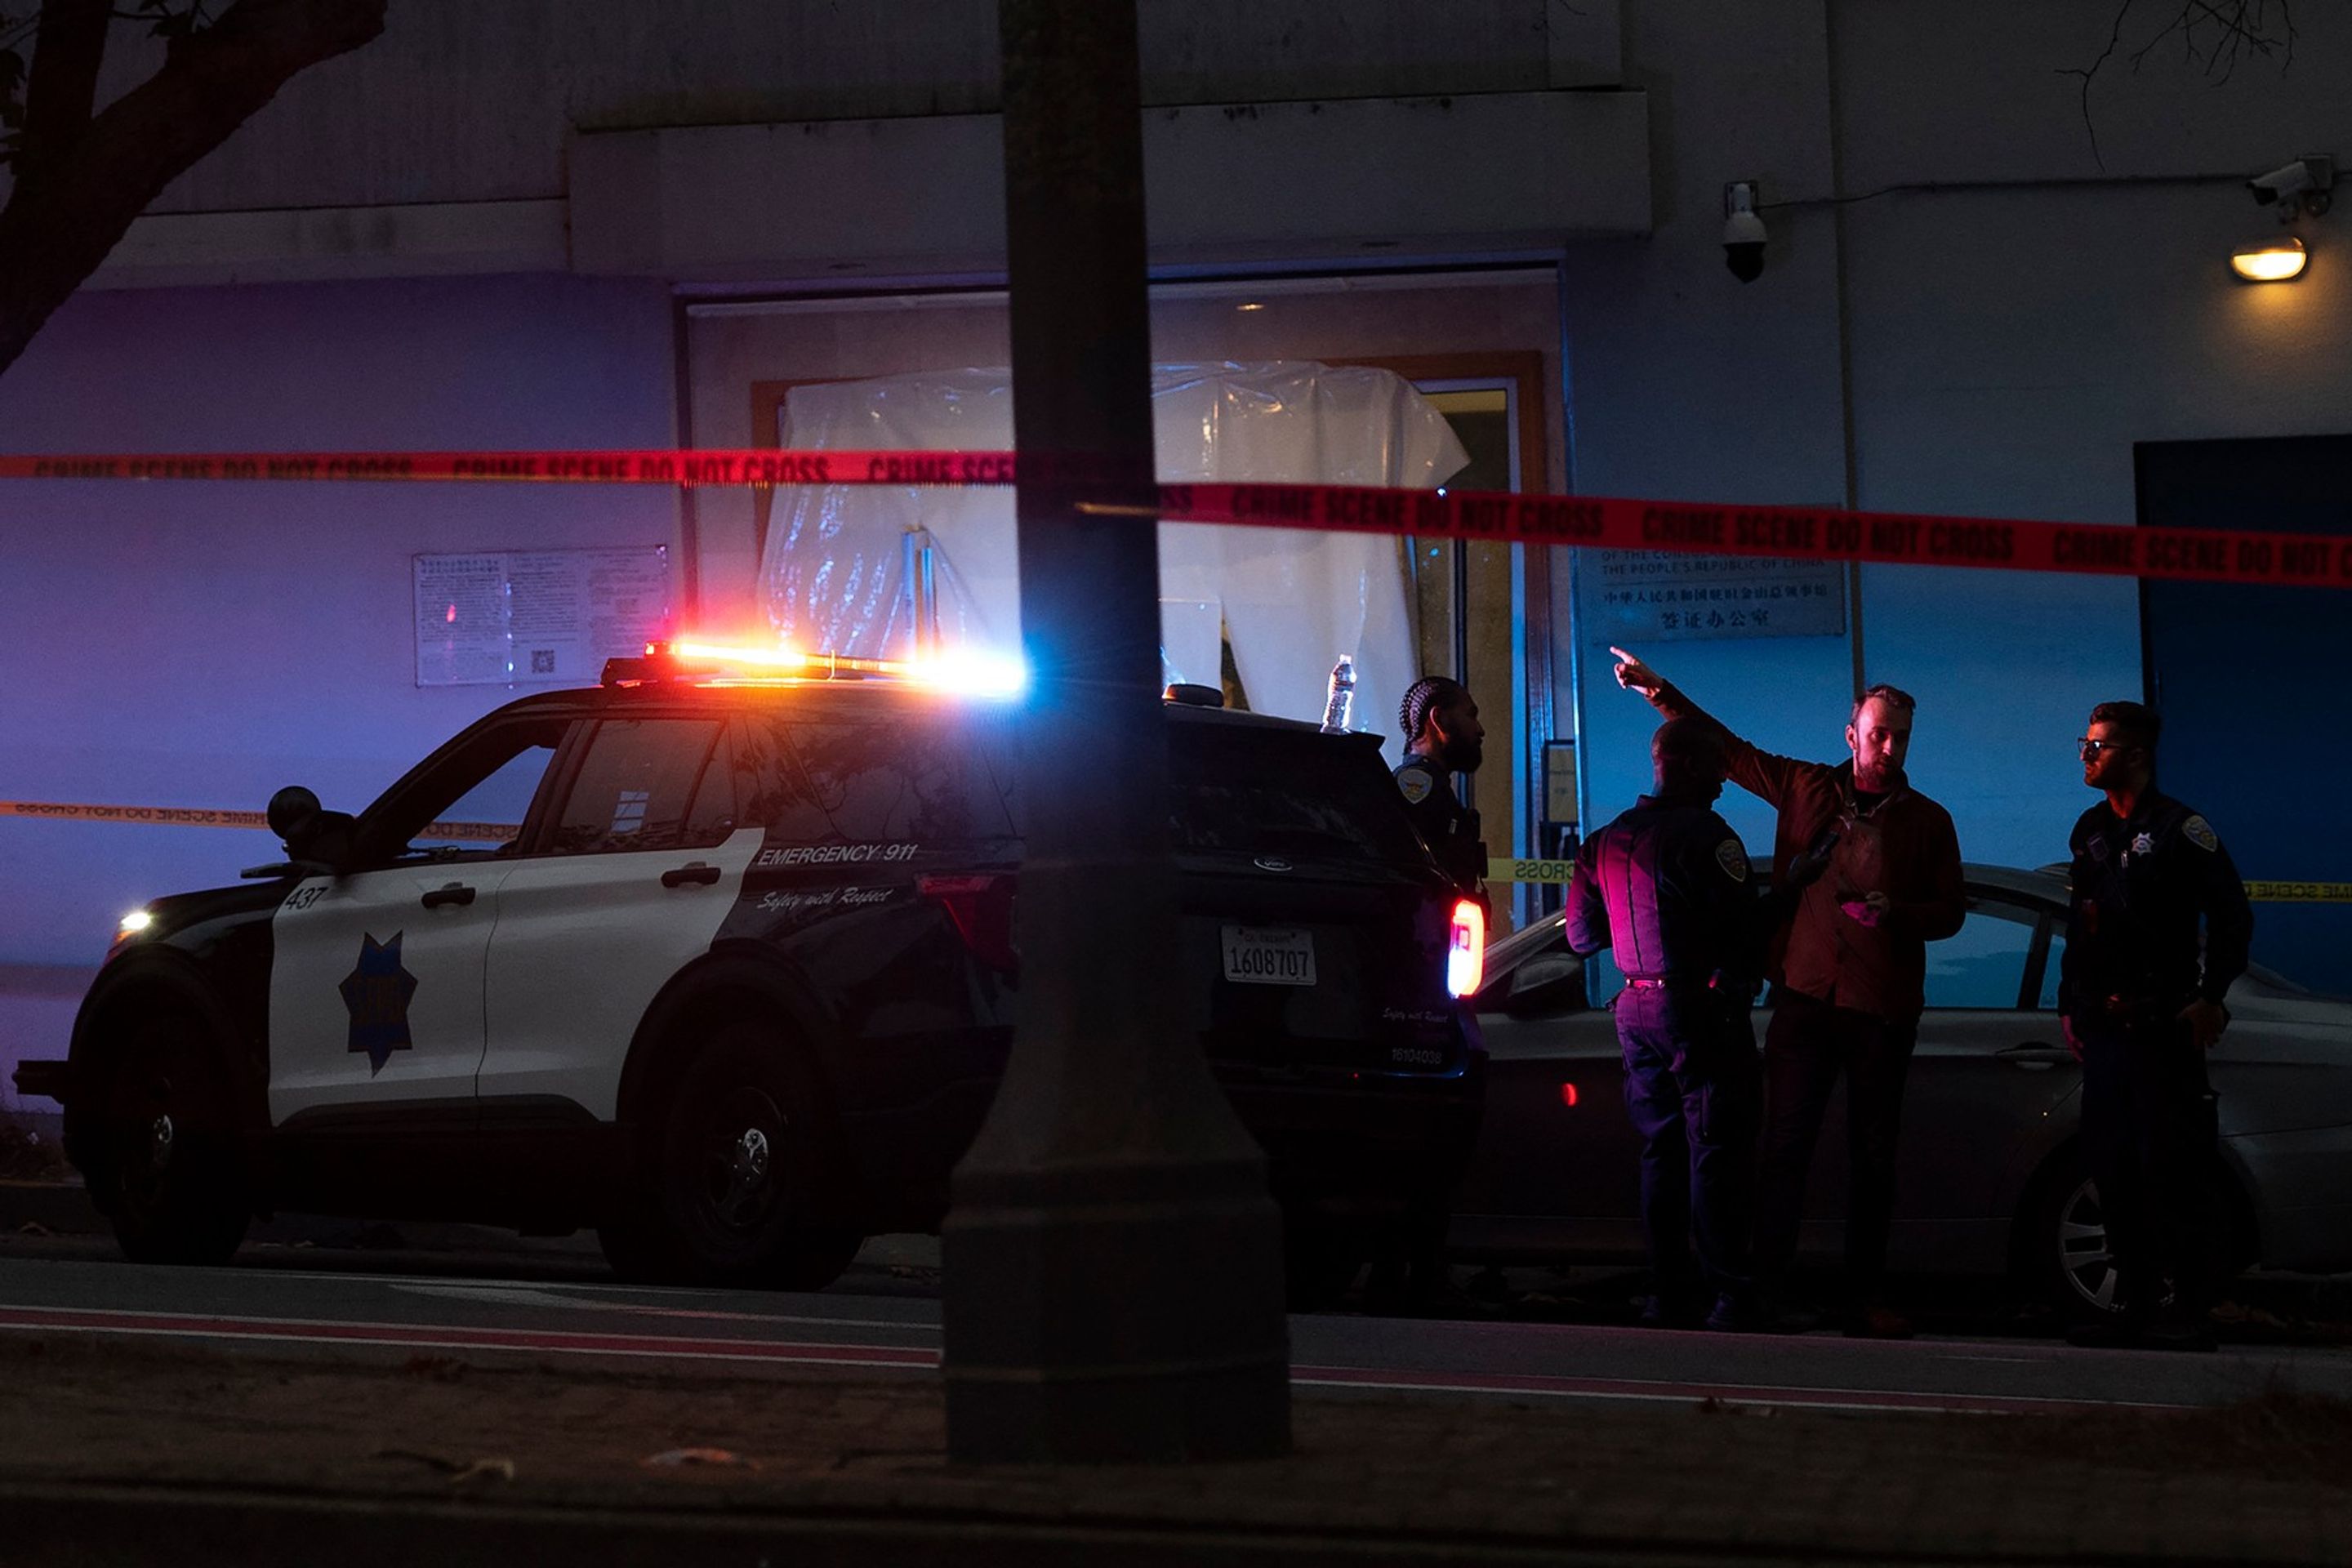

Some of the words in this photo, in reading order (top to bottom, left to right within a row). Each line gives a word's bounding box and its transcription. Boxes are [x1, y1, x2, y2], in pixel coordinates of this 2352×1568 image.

[684, 457, 733, 480] NOT
[744, 457, 829, 481] CROSS
[868, 457, 954, 481] CRIME
[960, 457, 1016, 481] SCE
[1232, 488, 1313, 519] CRIME
[1325, 490, 1405, 528] SCENE
[1417, 494, 1451, 528] DO
[1460, 497, 1508, 532] NOT
[1518, 500, 1602, 537] CROSS
[1642, 506, 1726, 545] CRIME
[1735, 511, 1816, 550] SCENE
[1827, 517, 1860, 552] DO
[1870, 519, 1919, 555] NOT
[1930, 522, 2014, 561] CROSS
[2053, 529, 2136, 568] CRIME
[2147, 535, 2228, 573] SCENE
[2237, 539, 2272, 575] DO
[2282, 541, 2332, 577] NOT
[1602, 564, 1626, 575] THE
[1630, 560, 1690, 574] PEOPLE'S
[1695, 557, 1757, 572] REPUBLIC
[1762, 558, 1777, 569] OF
[1660, 608, 1770, 630] 签证办公室
[757, 844, 881, 866] EMERGENCY
[883, 844, 919, 861] 911
[285, 886, 329, 910] 437
[1230, 947, 1308, 977] 1608707
